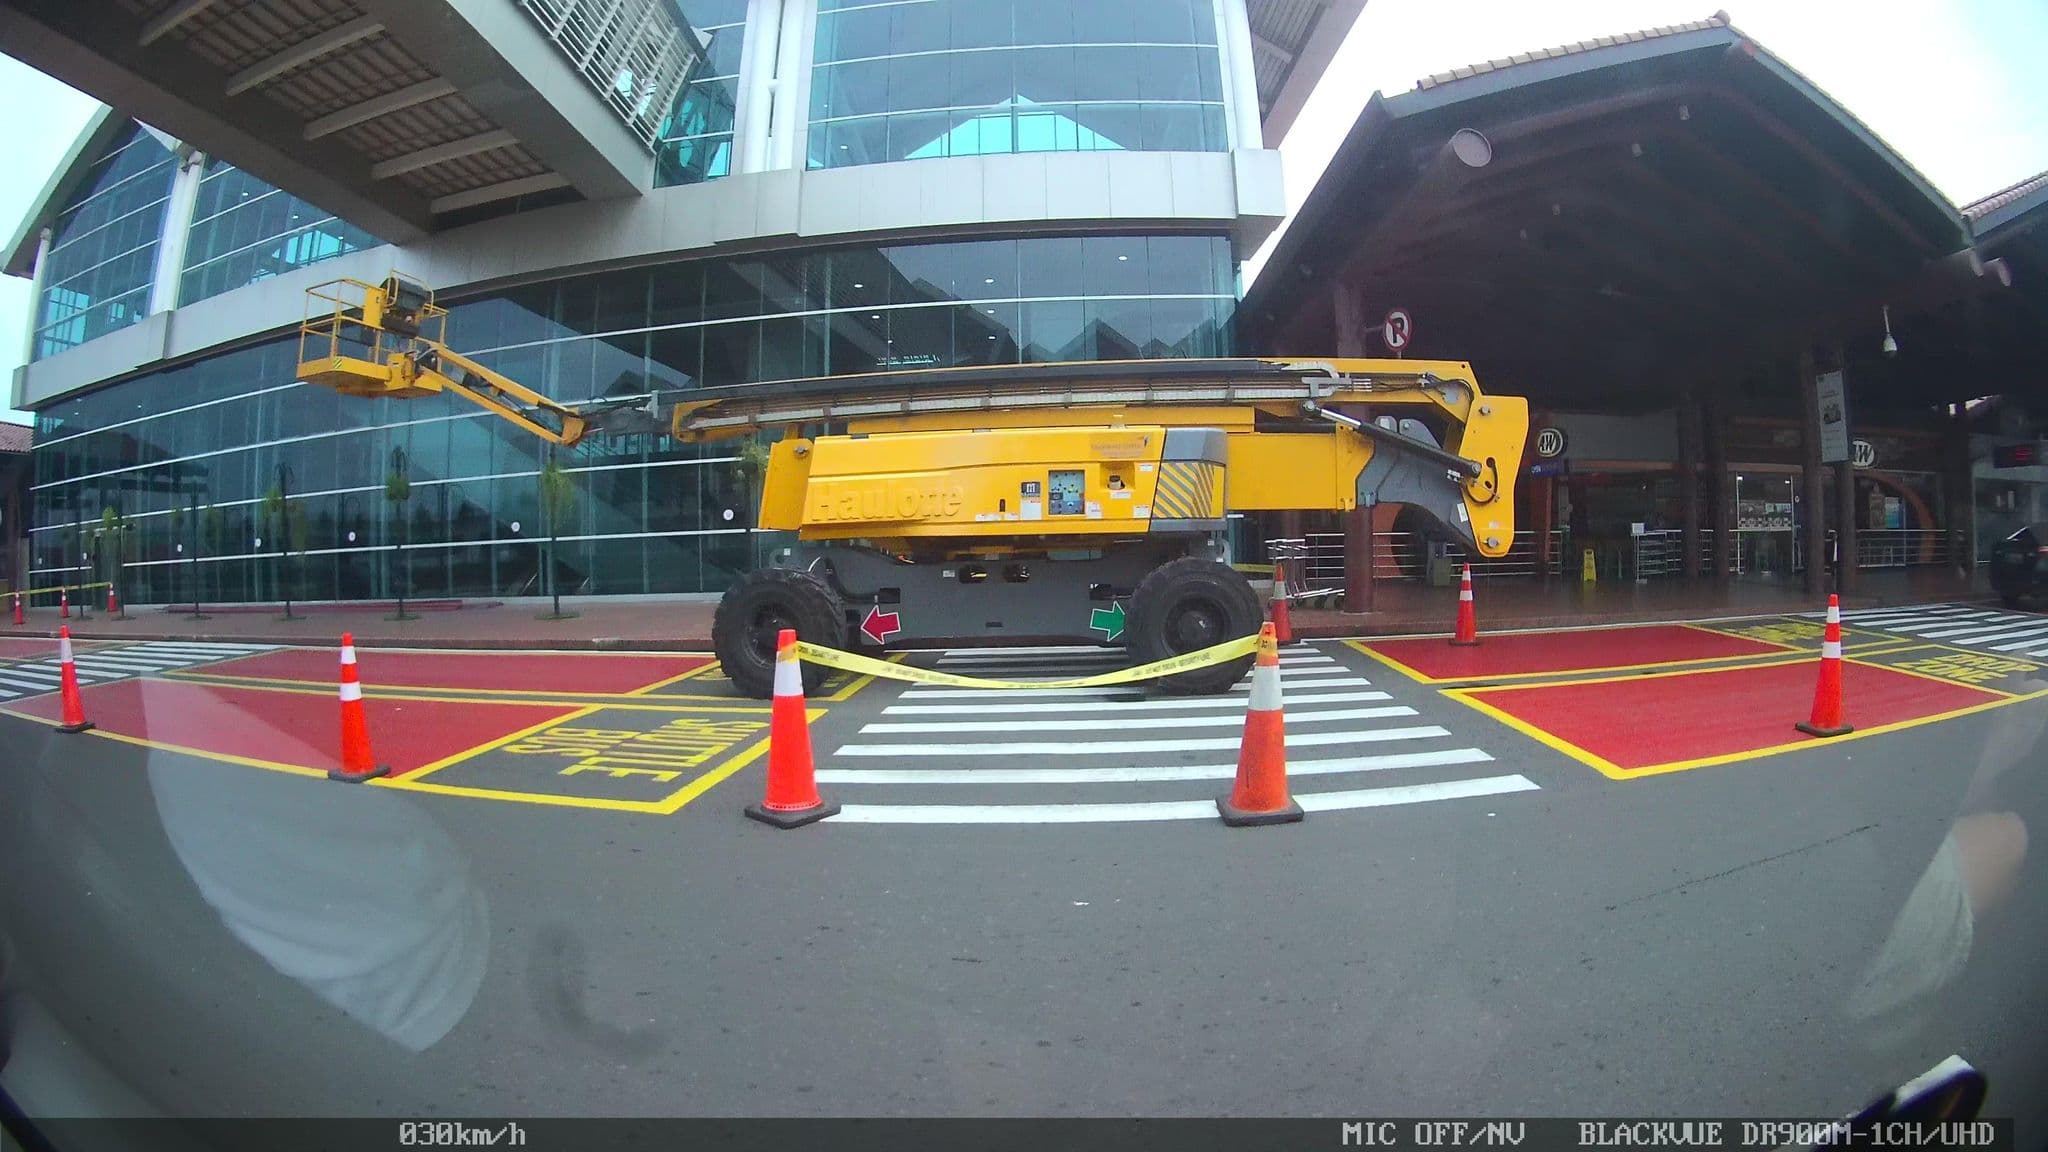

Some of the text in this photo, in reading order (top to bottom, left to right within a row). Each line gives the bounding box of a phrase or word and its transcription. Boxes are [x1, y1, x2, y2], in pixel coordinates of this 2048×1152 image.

[1890, 658, 2009, 683] ZONE
[1934, 653, 2040, 673] DROP
[502, 727, 641, 757] BUS
[557, 718, 771, 782] SHUTTLE
